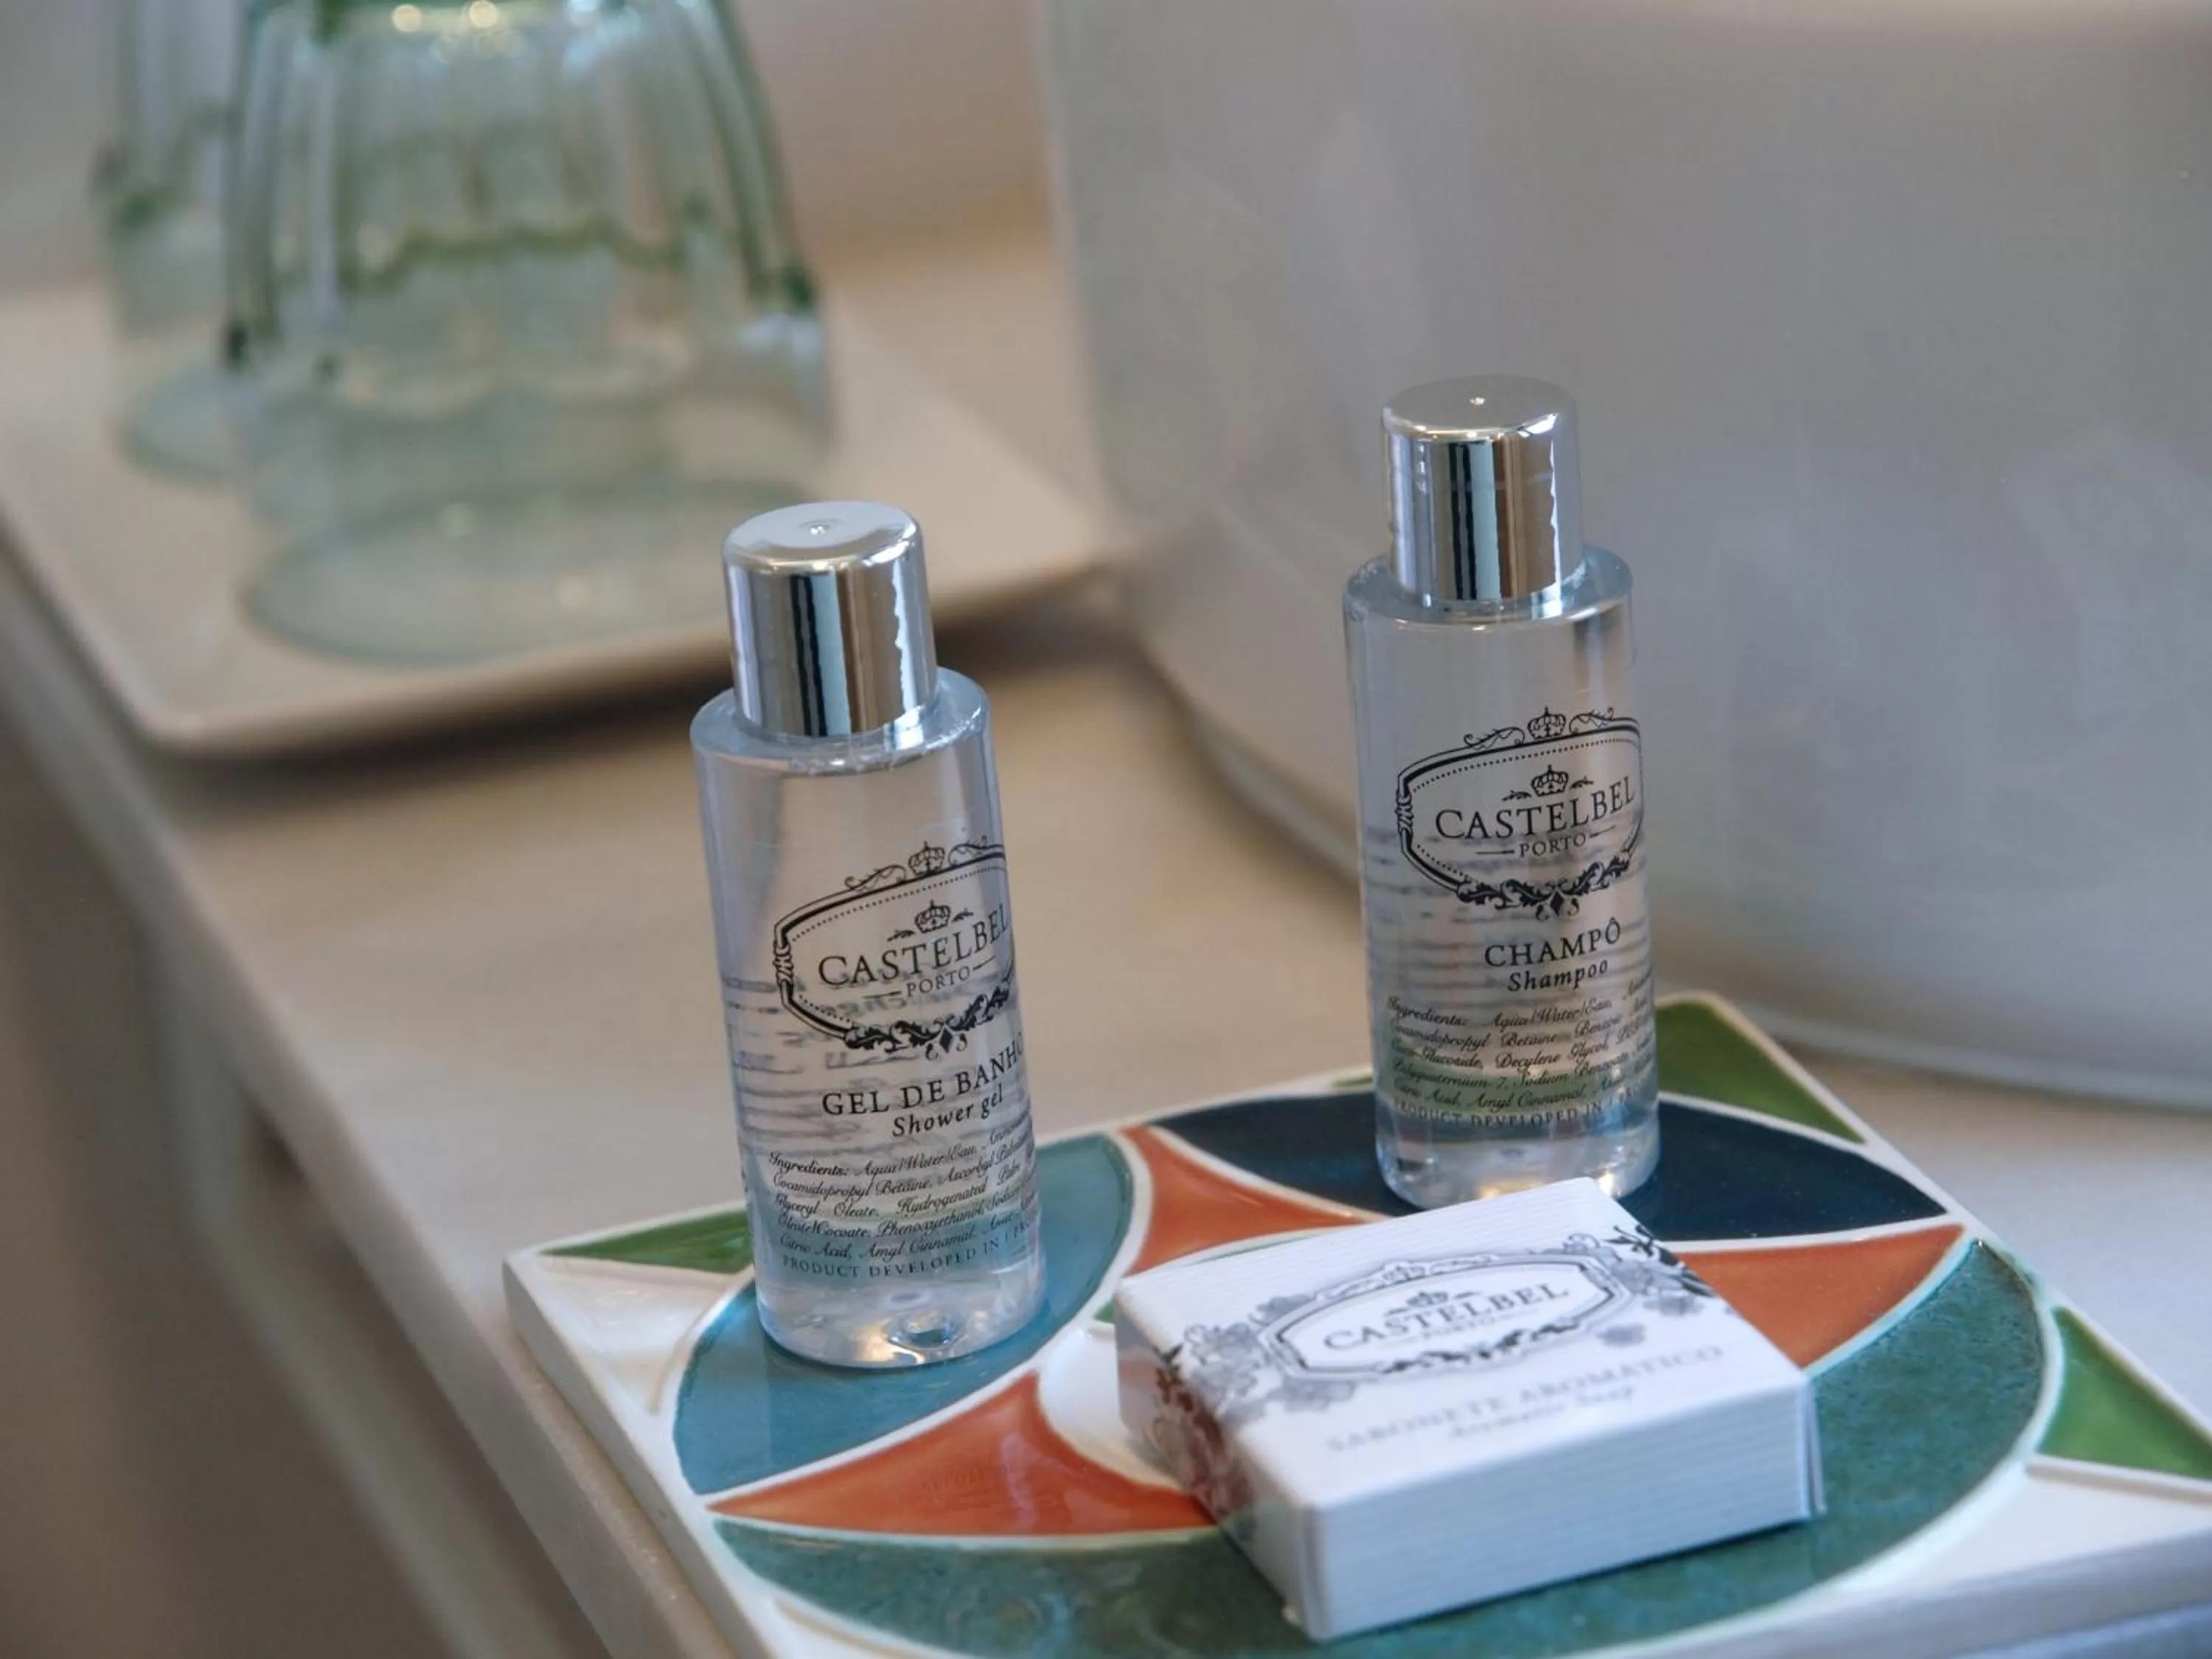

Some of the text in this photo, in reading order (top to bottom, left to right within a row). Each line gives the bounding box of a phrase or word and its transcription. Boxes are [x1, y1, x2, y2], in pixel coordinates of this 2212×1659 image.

[1435, 776, 1635, 840] CASTELBEL
[1519, 833, 1587, 858] PORTO
[818, 903, 1008, 987] CASTELBEL
[1484, 917, 1621, 968] CHAMPÔ
[906, 965, 971, 998] PORTO
[1507, 959, 1609, 992] Shampoo
[821, 1089, 890, 1116] GEL
[900, 1079, 945, 1109] DE
[891, 1082, 1003, 1138] Shower gel
[768, 1150, 849, 1176] Ingredients:
[782, 1254, 860, 1278] PRODUCT
[868, 1248, 976, 1278] DEVELOPED
[1324, 1283, 1569, 1351] CASTELBEL
